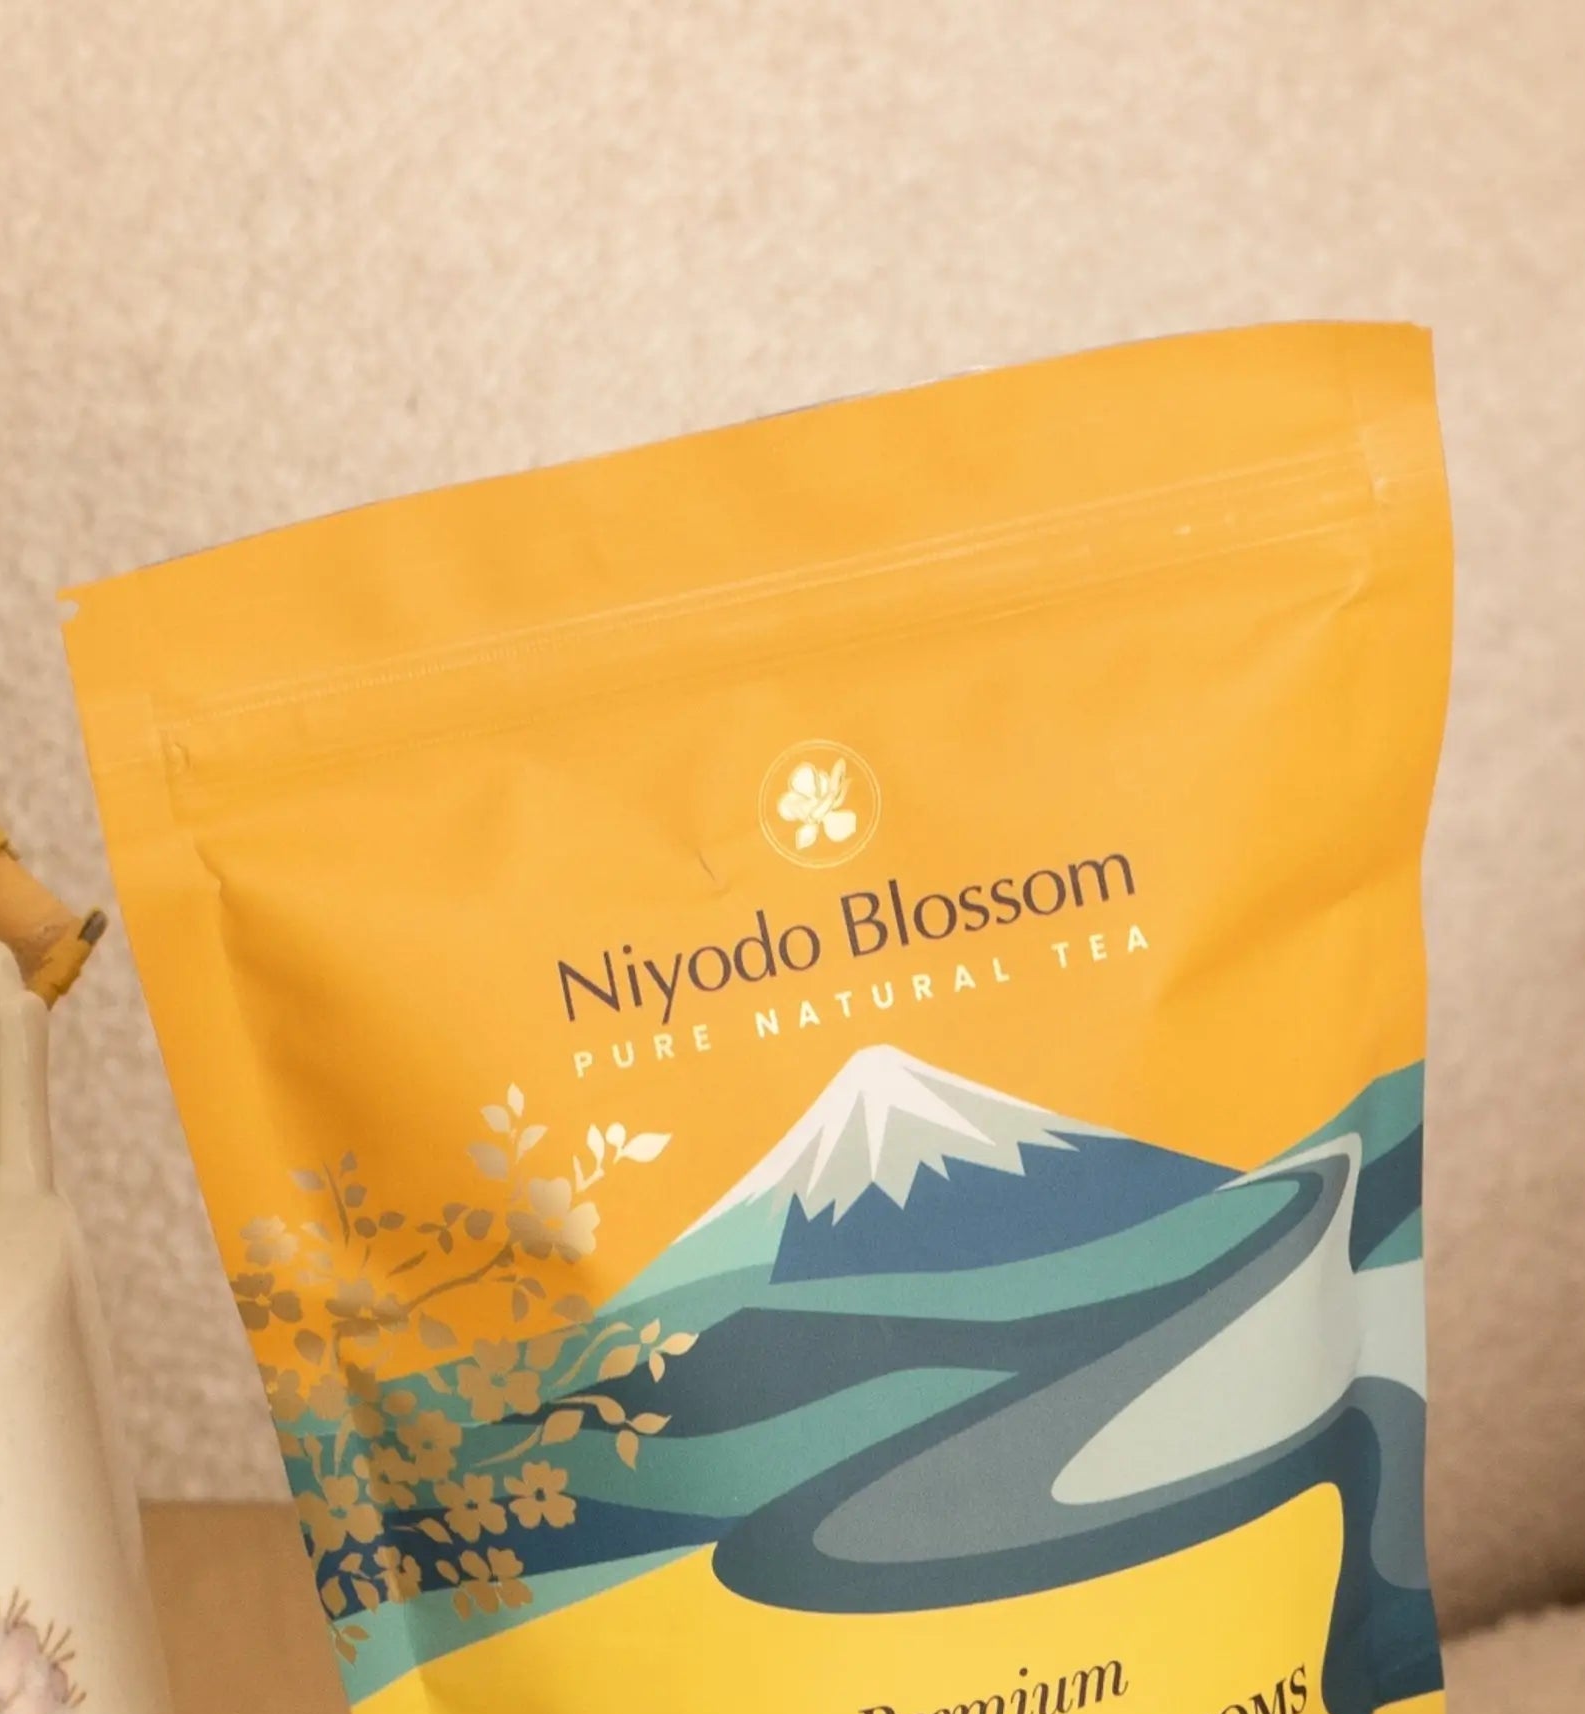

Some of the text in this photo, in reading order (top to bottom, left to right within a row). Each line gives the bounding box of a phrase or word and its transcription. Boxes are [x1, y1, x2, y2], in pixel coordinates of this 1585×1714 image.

[557, 853, 1136, 1026] Niyodo Blossom
[573, 923, 1149, 1079] PURE NATURAL TEA
